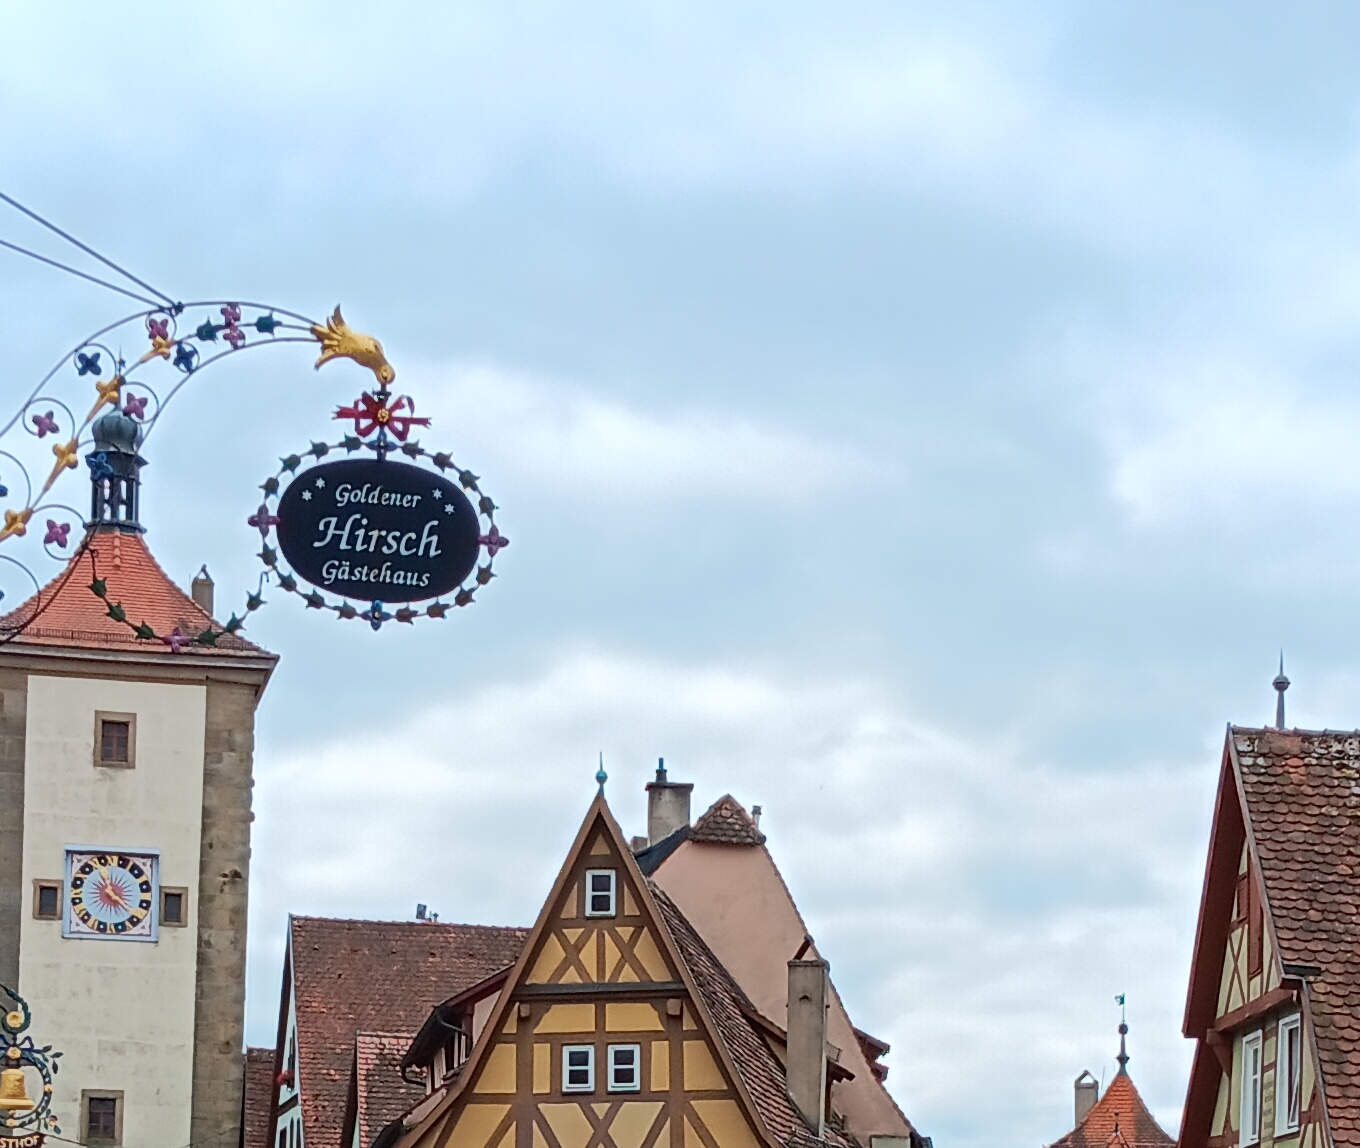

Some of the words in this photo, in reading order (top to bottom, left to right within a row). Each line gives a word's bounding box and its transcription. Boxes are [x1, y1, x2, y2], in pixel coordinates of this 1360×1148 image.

[335, 484, 421, 508] Goldener
[313, 514, 442, 557] Hirsch
[322, 560, 431, 587] Gästehaus
